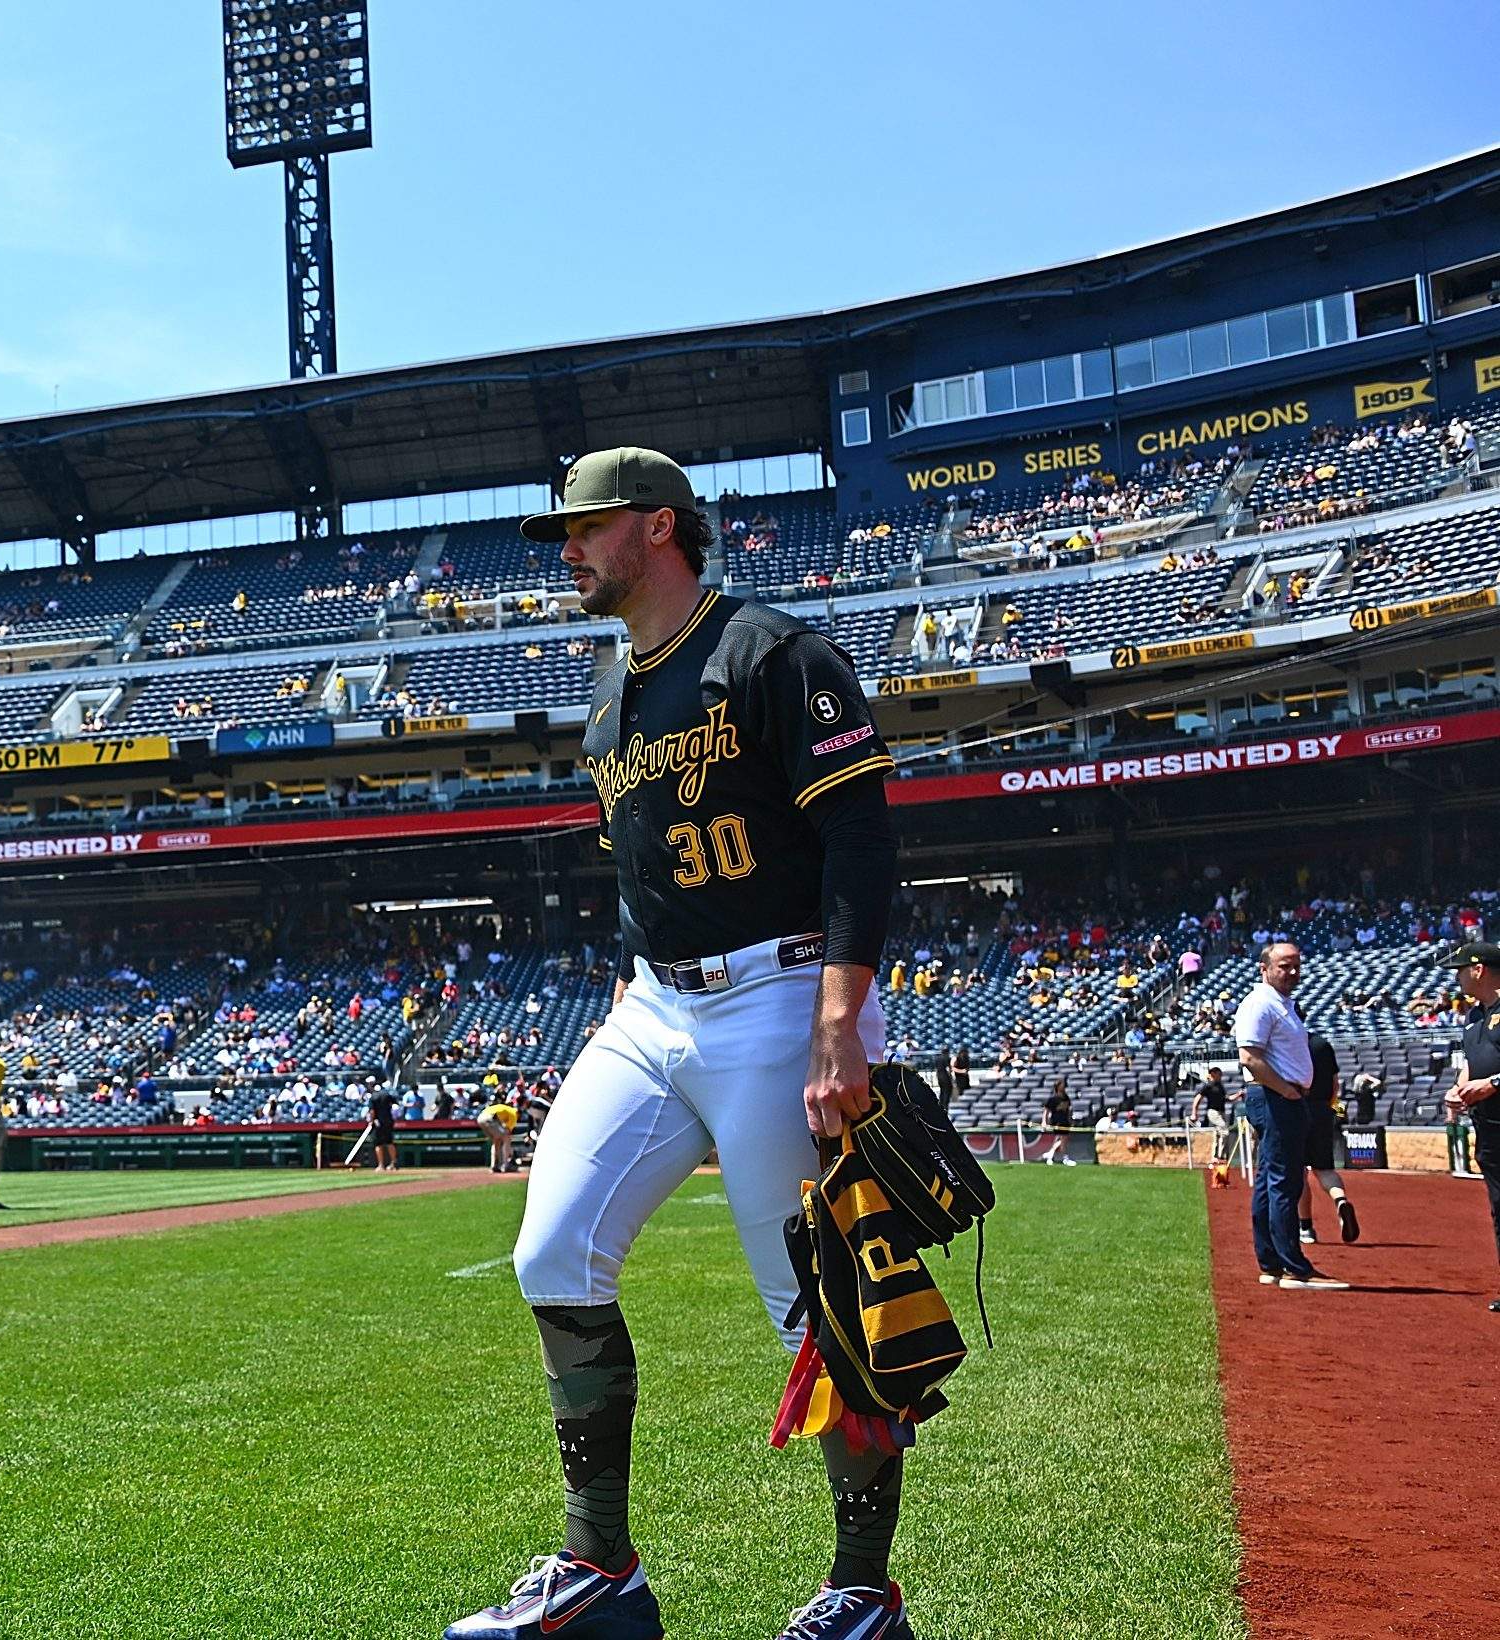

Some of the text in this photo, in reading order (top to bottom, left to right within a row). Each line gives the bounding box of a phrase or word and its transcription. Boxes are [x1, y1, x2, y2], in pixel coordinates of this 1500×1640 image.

[1361, 386, 1414, 410] 1909
[907, 401, 1309, 492] WORLD SERIES CHAMPIONS
[1351, 607, 1379, 631] 40
[1116, 634, 1245, 668] 21 ROBERTO CLEMENTE
[880, 676, 903, 697] 20
[817, 695, 835, 719] 9
[266, 727, 305, 747] AHN
[815, 727, 871, 753] SHEETZ
[1368, 728, 1438, 746] SHEETZ
[25, 745, 60, 768] PM
[1000, 735, 1343, 792] GAME PRESENTED BY
[111, 834, 143, 851] BY
[667, 813, 757, 888] 30
[705, 969, 725, 982] 30
[858, 1236, 920, 1282] P
[561, 1440, 577, 1453] SA
[835, 1491, 868, 1503] USA
